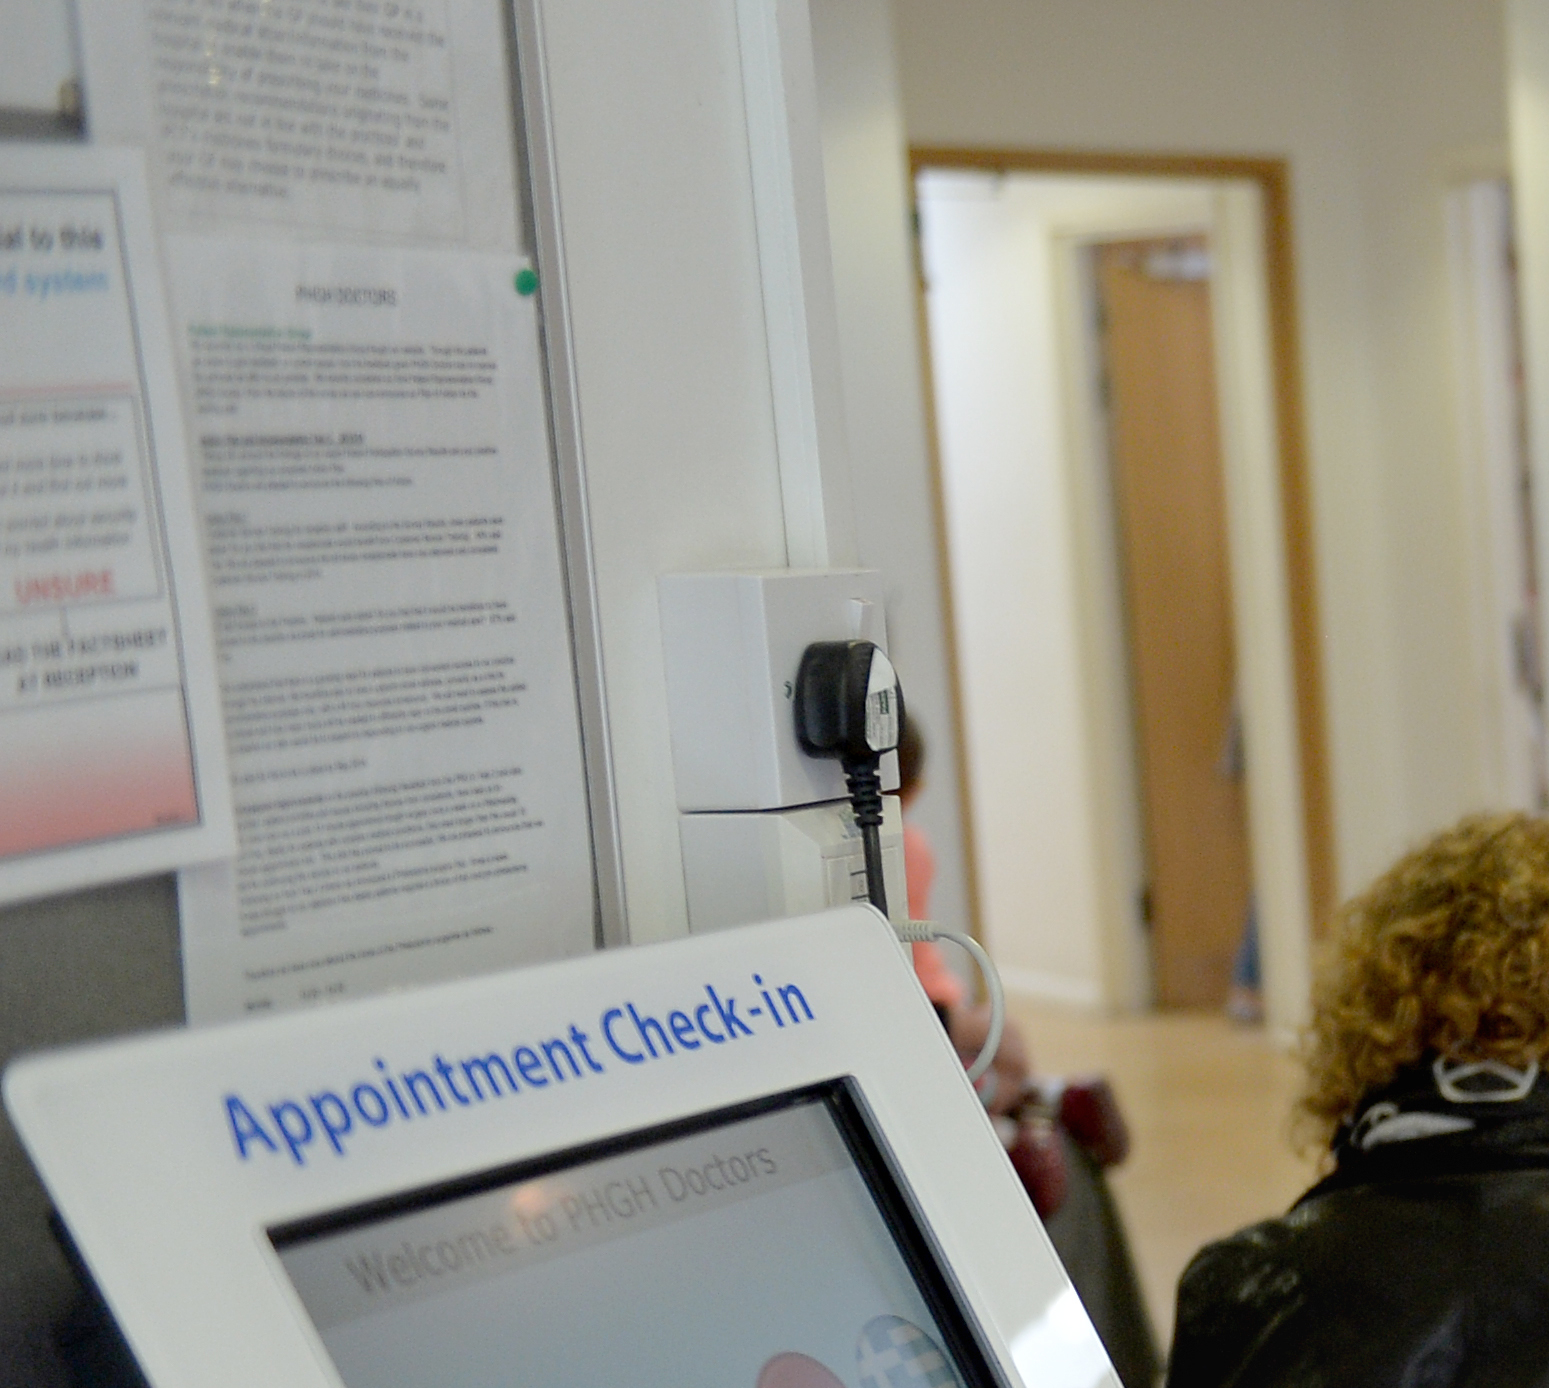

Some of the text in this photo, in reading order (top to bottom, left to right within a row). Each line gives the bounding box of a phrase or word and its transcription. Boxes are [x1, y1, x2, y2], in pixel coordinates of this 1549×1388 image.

[14, 569, 116, 604] UNSURE
[224, 974, 815, 1166] Appointment Check-in
[344, 1145, 778, 1293] Welcome to PHGH Doctors
